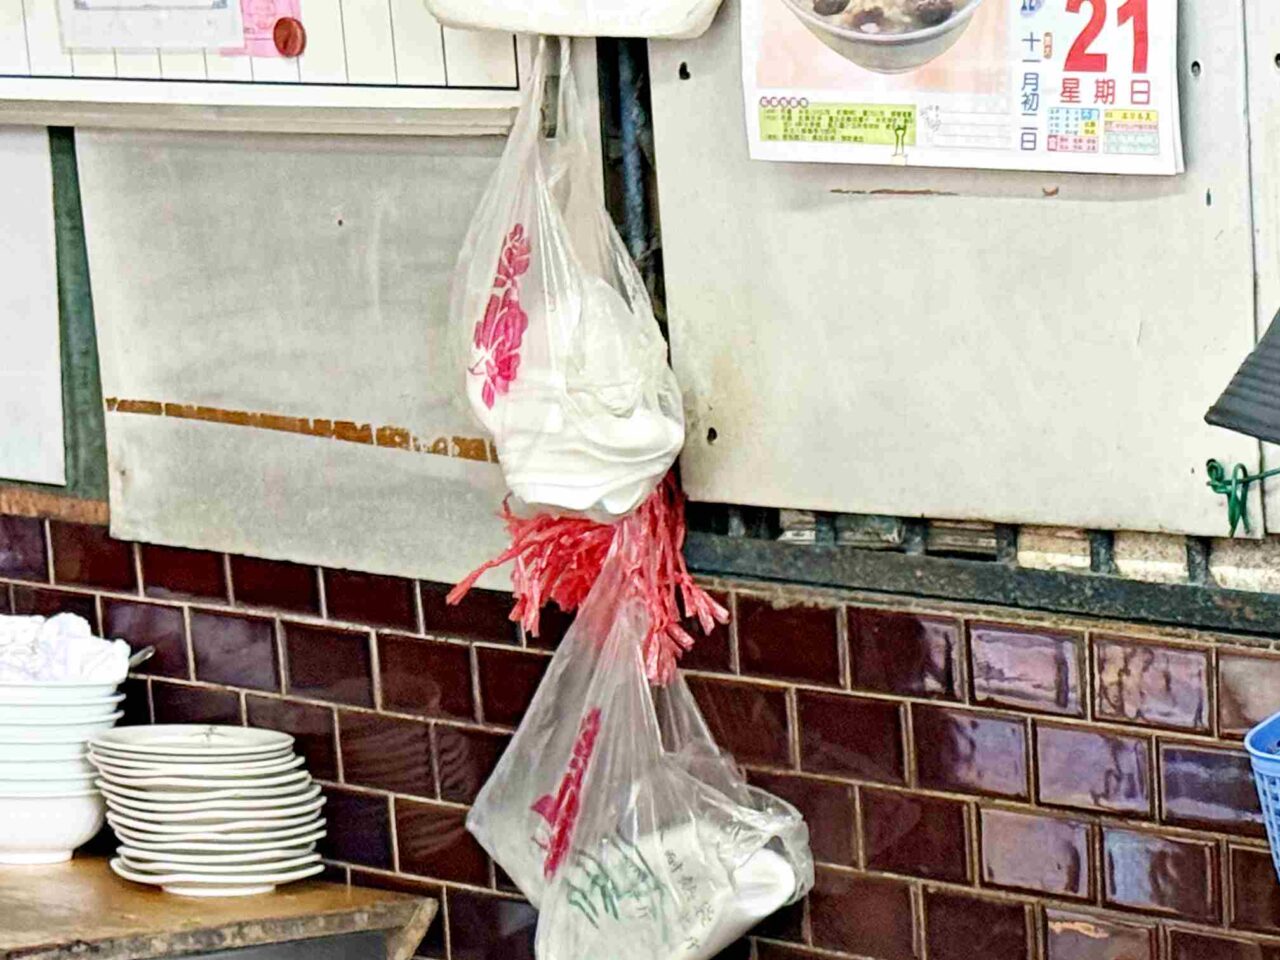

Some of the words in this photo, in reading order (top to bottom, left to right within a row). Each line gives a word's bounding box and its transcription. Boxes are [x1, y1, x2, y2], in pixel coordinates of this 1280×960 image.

[1063, 0, 1149, 74] 21
[1020, 31, 1042, 152] 十一月初二日
[1060, 77, 1151, 106] 星期日
